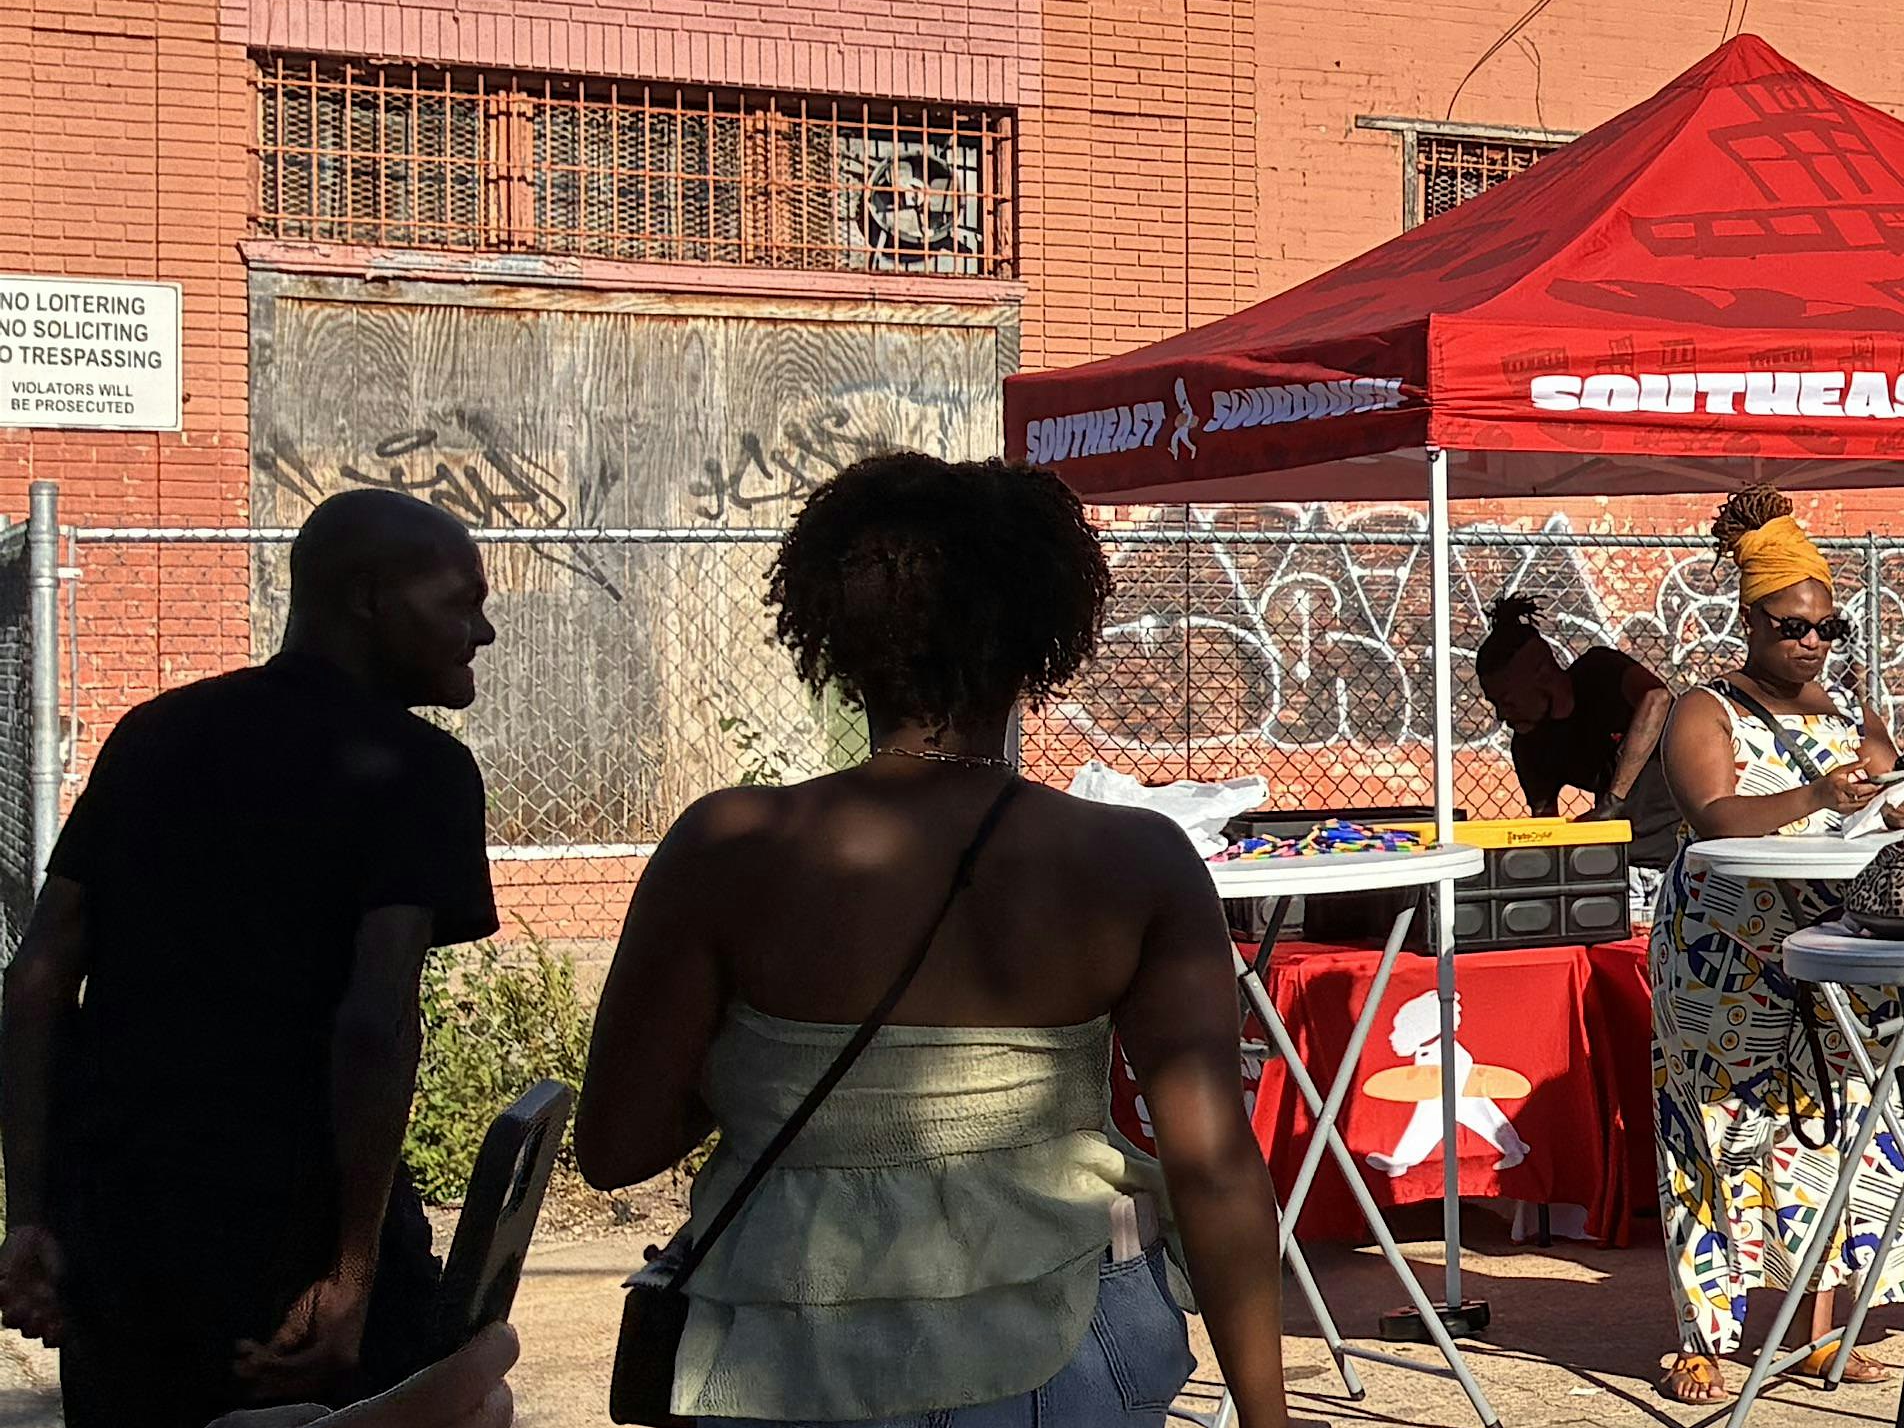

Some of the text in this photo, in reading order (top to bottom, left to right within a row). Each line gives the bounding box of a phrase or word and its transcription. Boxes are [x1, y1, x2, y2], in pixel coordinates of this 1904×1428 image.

[0, 292, 146, 315] NO LOITERING
[33, 320, 149, 342] SOLICITING
[19, 346, 162, 370] TRESPASSING
[12, 381, 134, 397] VIOLATORS WILL
[11, 398, 135, 414] BE PROSECUTED
[1025, 400, 1166, 467] SOUTHEAST
